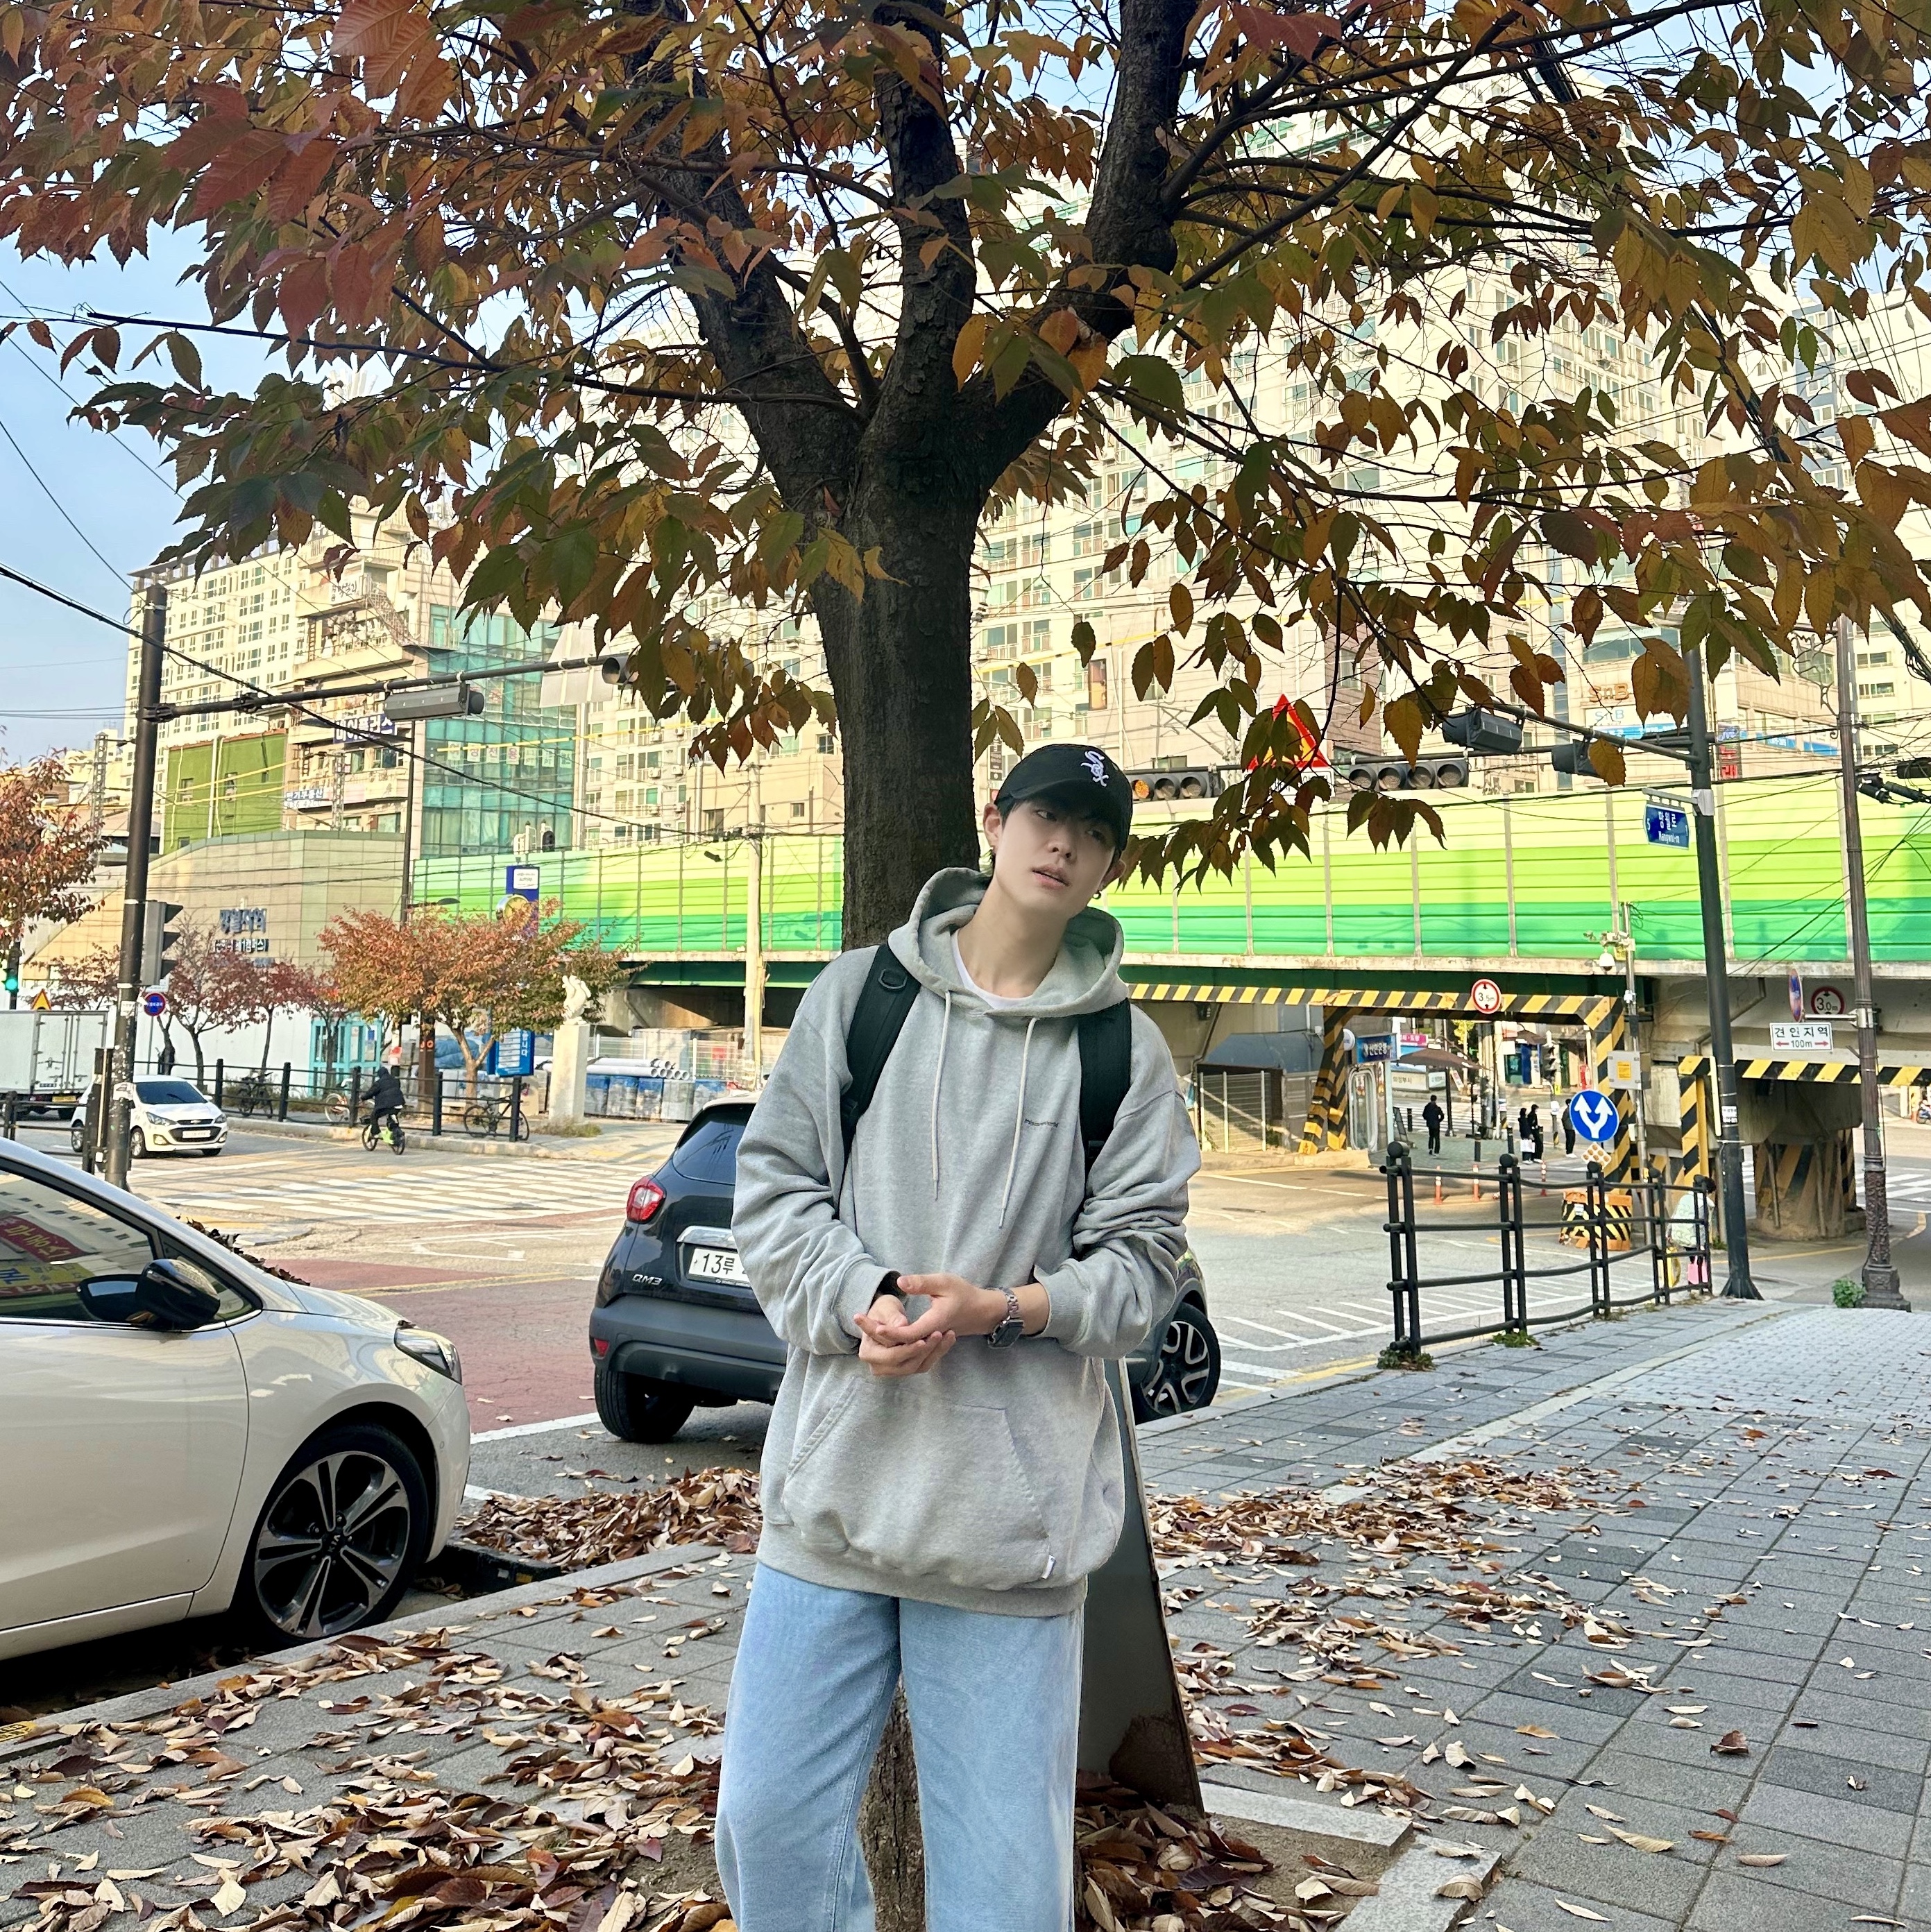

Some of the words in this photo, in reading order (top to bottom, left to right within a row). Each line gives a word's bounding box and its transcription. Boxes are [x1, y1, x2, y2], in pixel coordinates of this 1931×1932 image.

[1589, 683, 1629, 702] SnB
[1478, 992, 1495, 1002] 3.5m
[1817, 997, 1838, 1011] 3.0m
[632, 1274, 663, 1285] QM3
[327, 1535, 341, 1553] KIA
